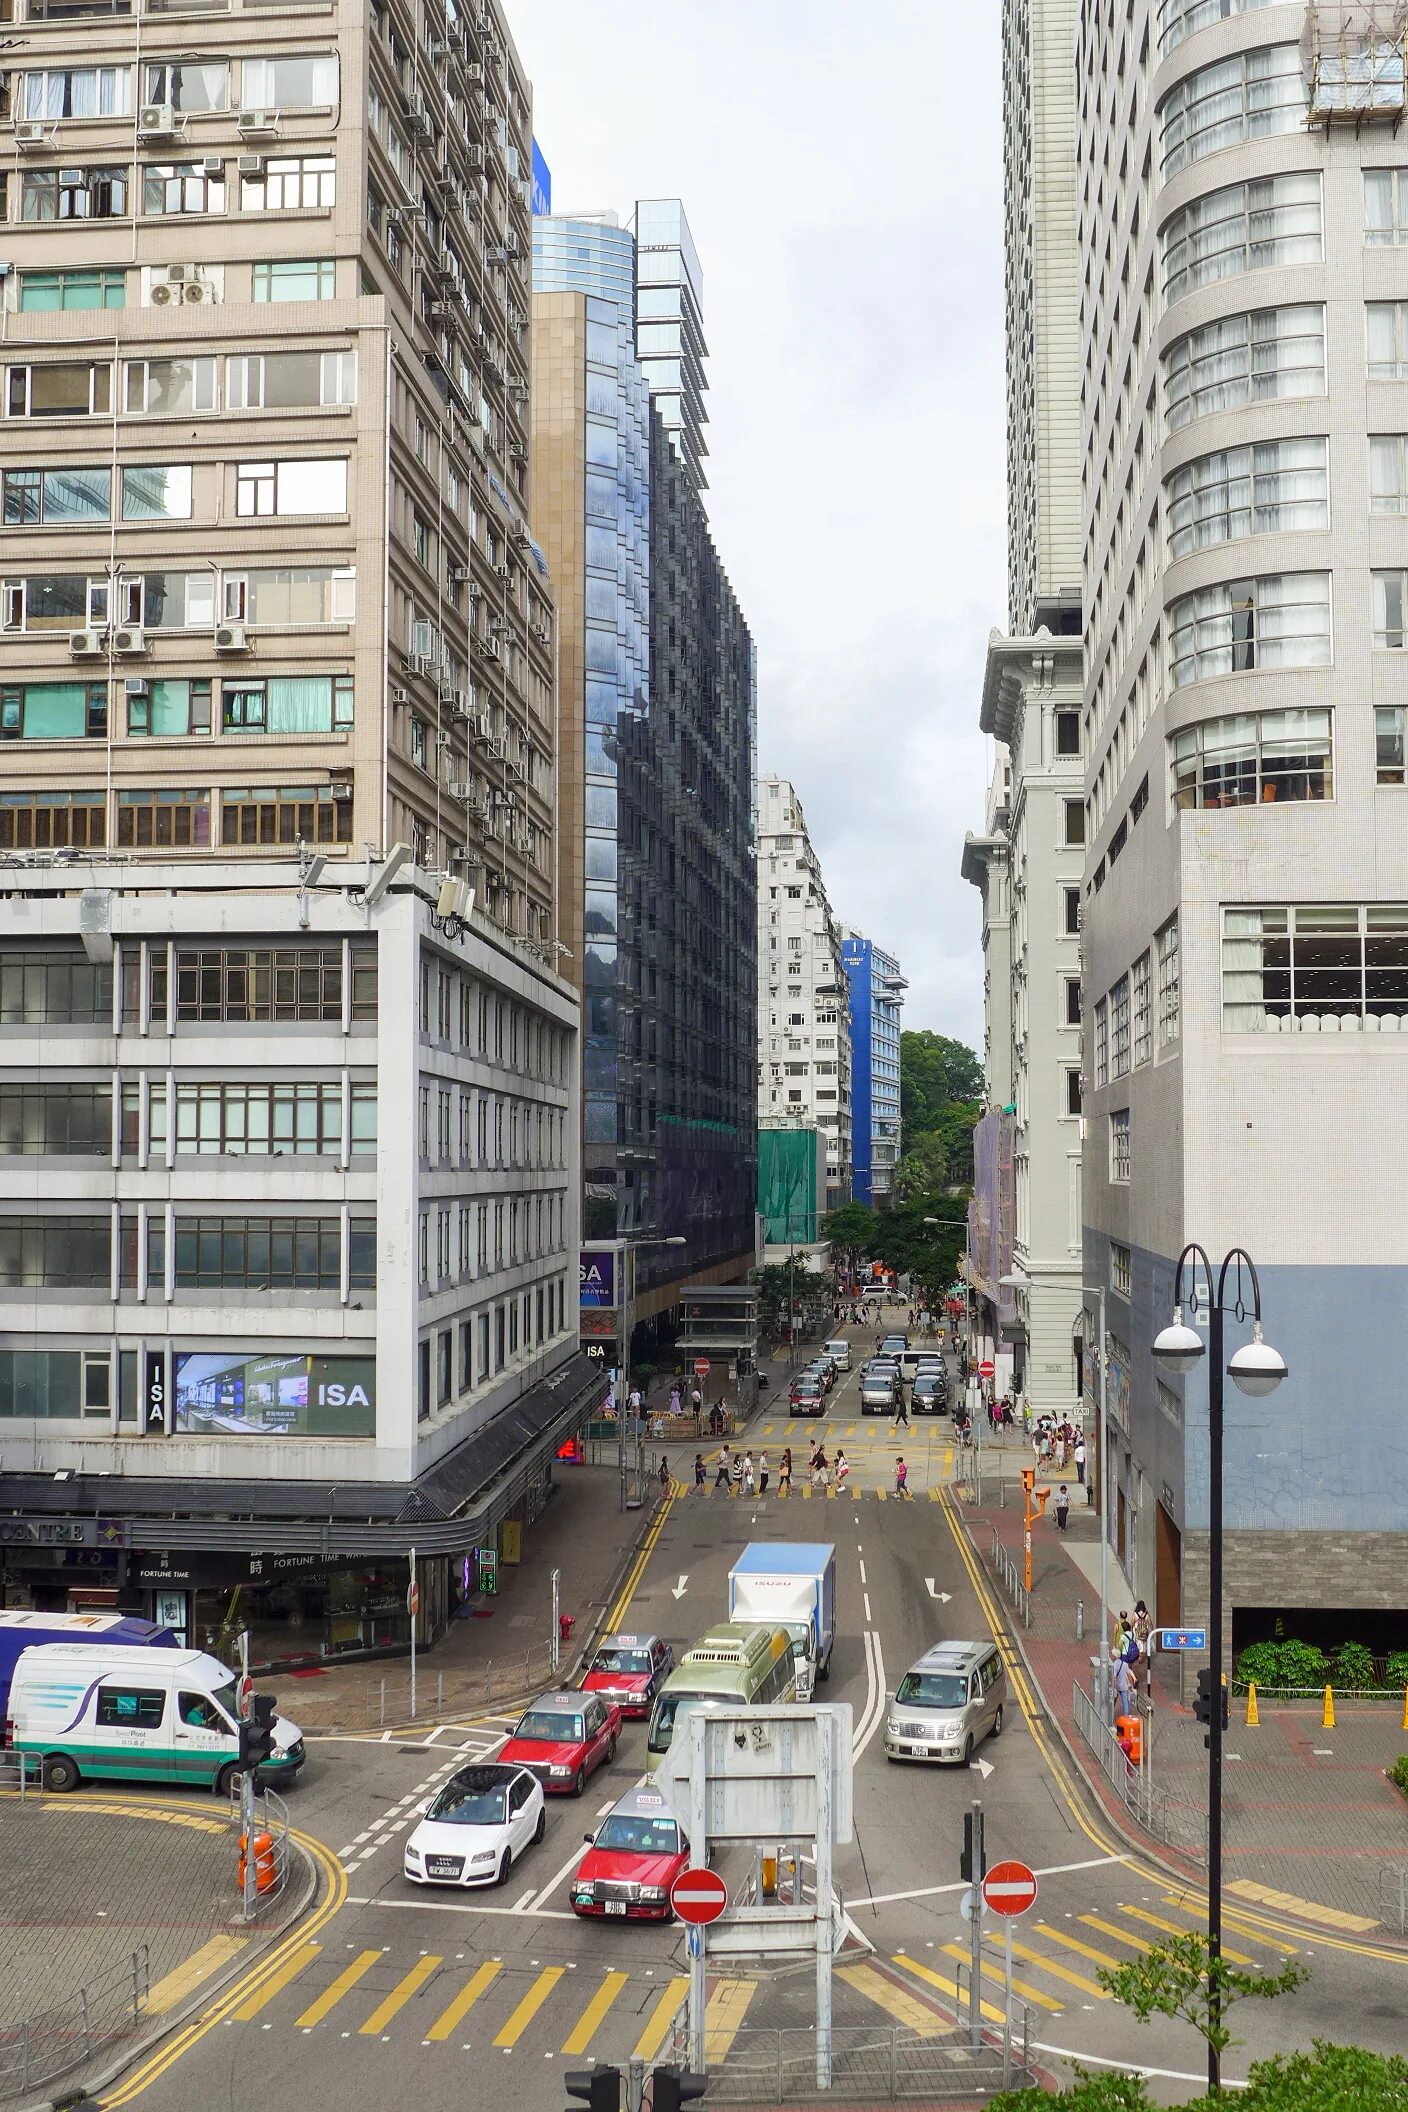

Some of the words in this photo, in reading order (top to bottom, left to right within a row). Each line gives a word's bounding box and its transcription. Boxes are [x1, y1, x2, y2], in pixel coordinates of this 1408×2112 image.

[587, 1346, 605, 1357] ISA
[149, 1365, 164, 1421] ISA
[318, 1384, 370, 1406] ISA
[273, 1555, 315, 1569] FORTUNE
[320, 1554, 340, 1564] TIME
[140, 1570, 172, 1578] FORTUNE
